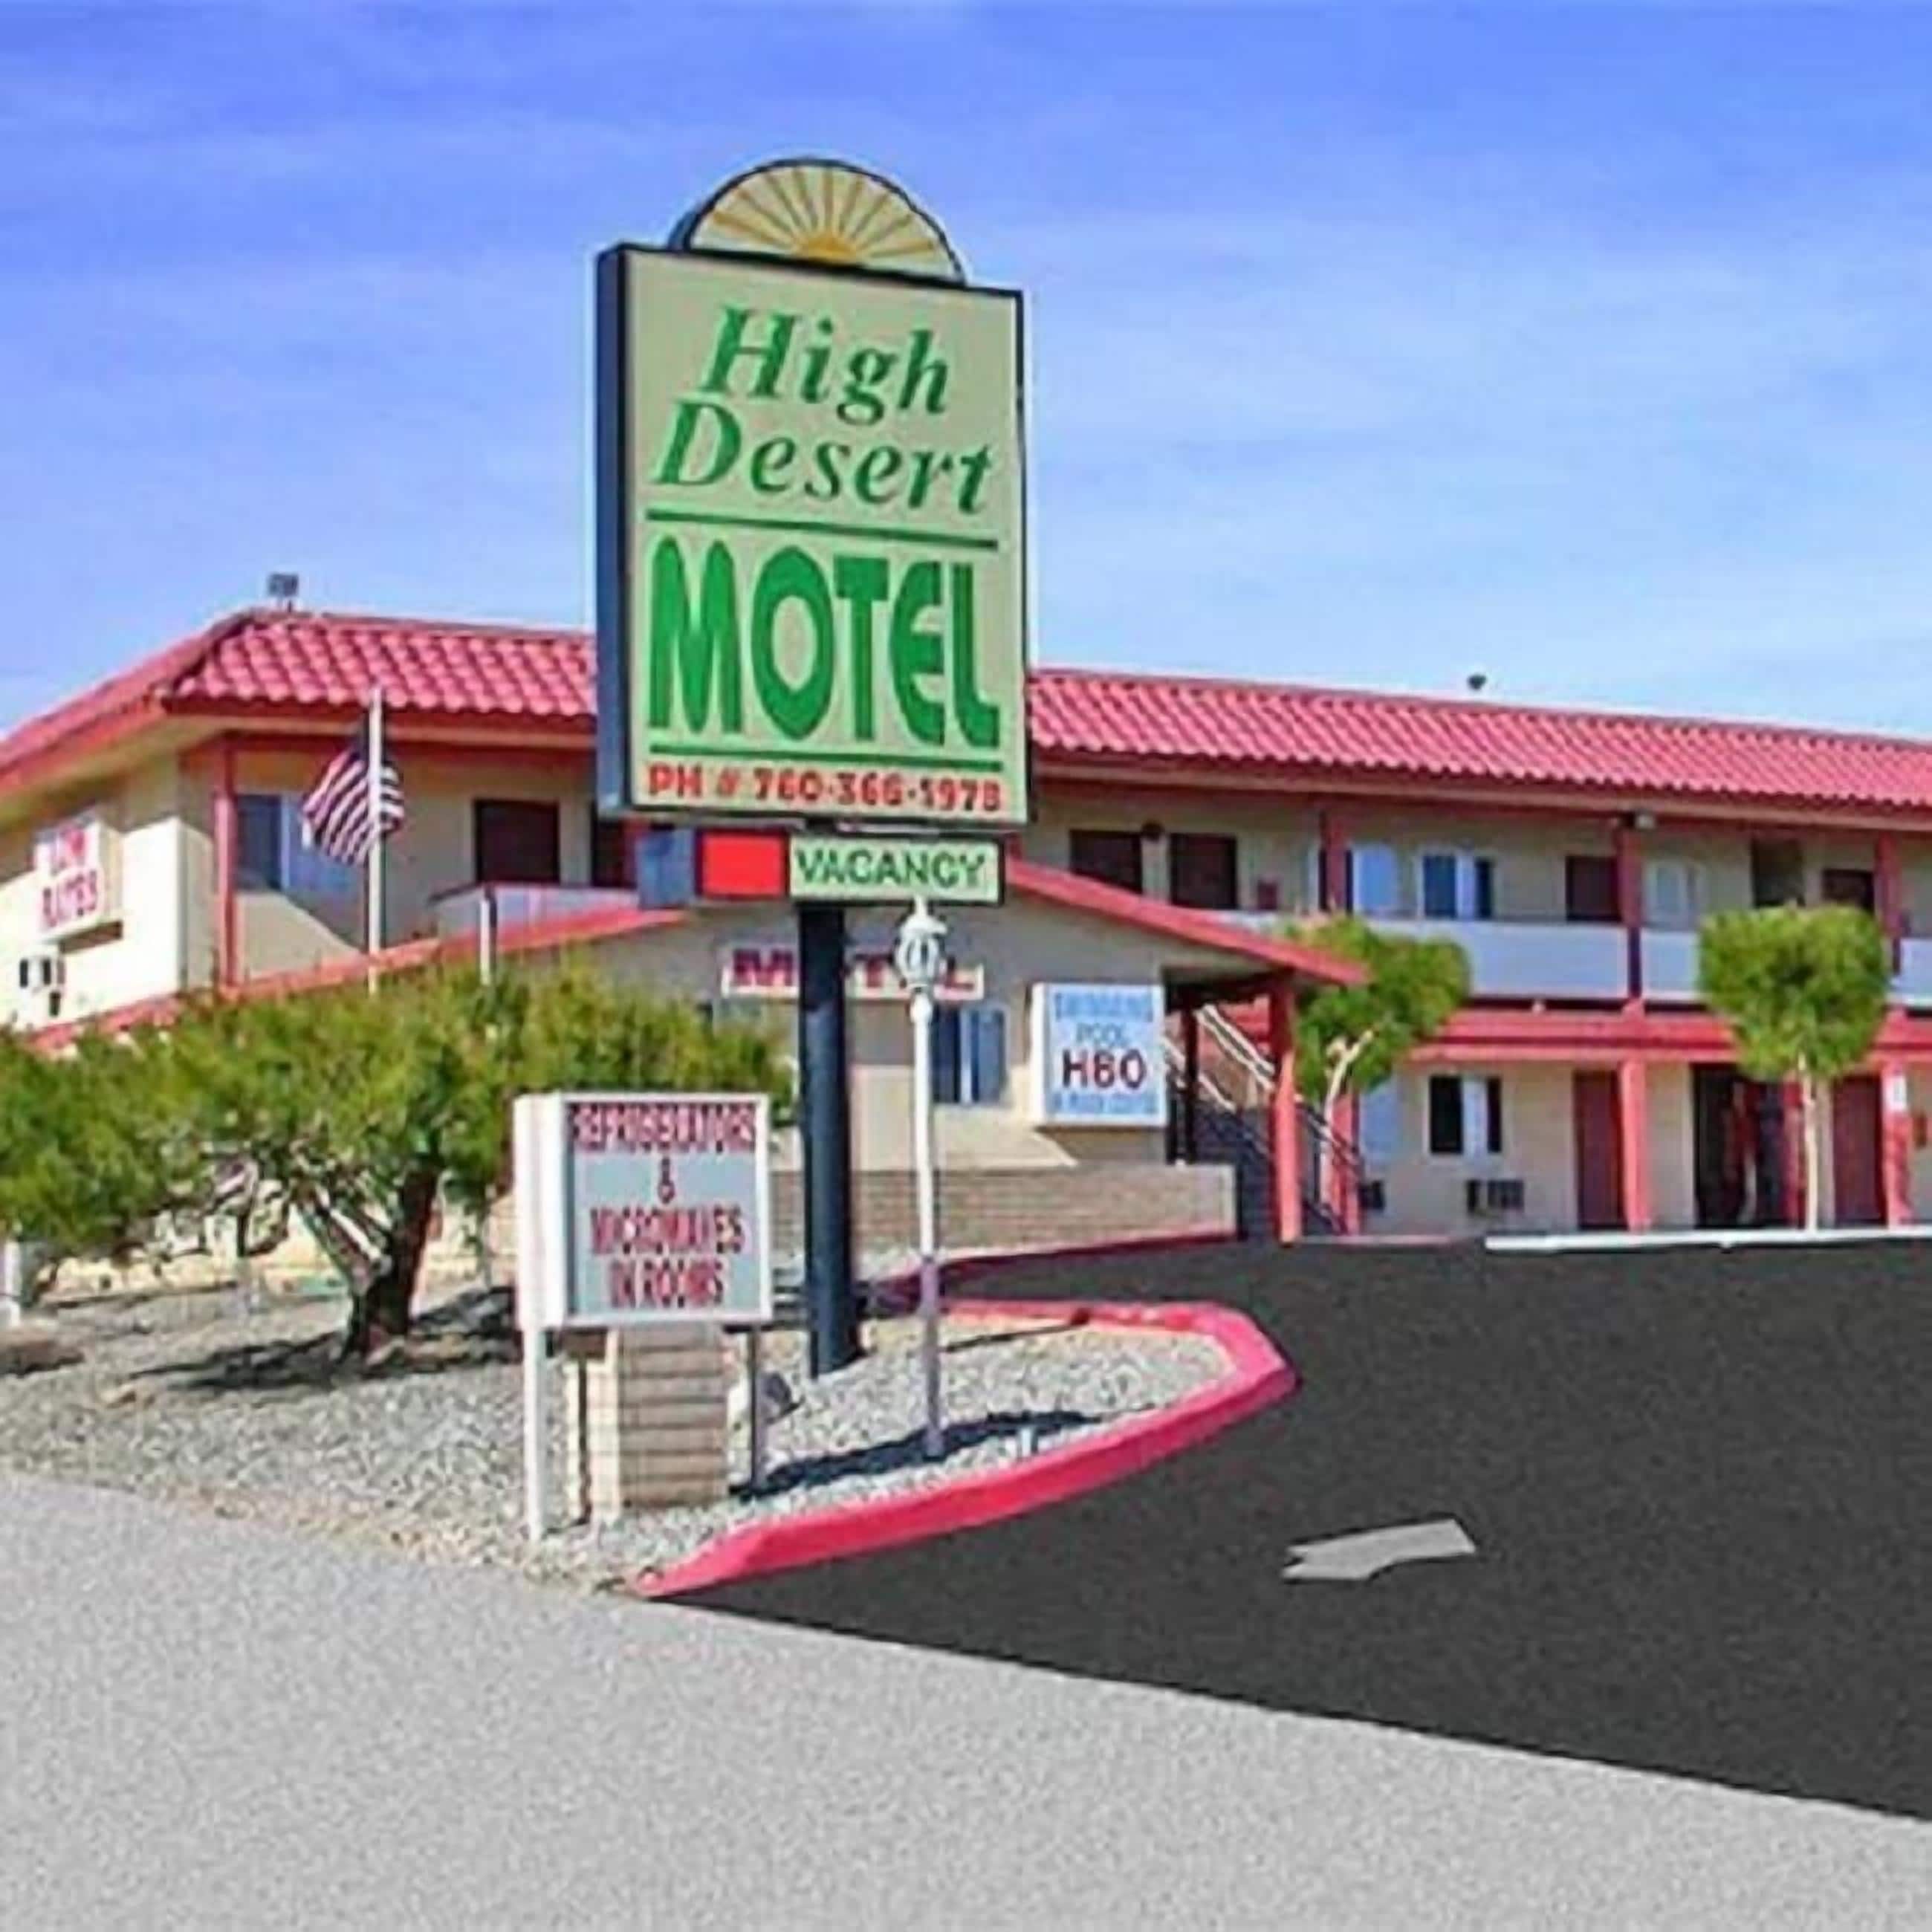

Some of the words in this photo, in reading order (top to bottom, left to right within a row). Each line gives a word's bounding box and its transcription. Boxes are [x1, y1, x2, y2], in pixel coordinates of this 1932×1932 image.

[698, 305, 953, 427] High
[652, 398, 993, 516] Desert
[649, 537, 1000, 749] MOTEL
[646, 765, 702, 798] PH
[795, 849, 985, 889] VACANCY
[731, 947, 976, 991] MTL
[1063, 1048, 1147, 1090] HBO
